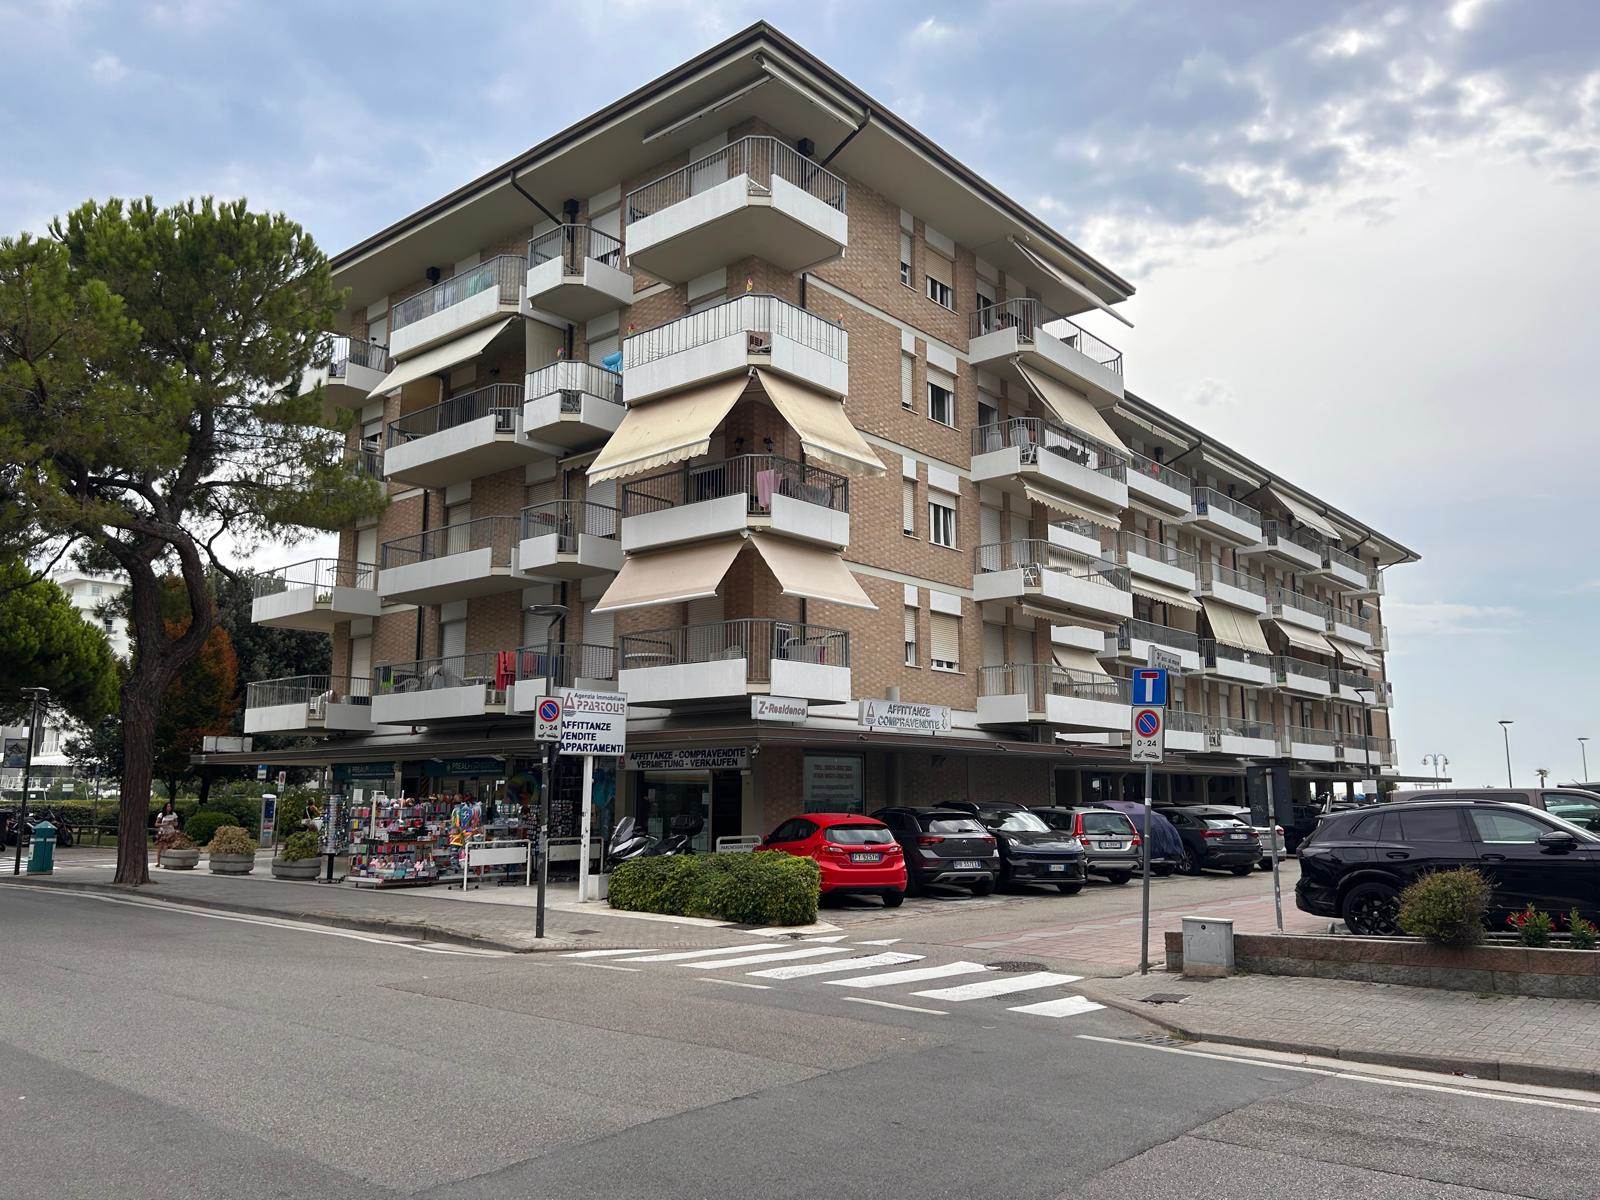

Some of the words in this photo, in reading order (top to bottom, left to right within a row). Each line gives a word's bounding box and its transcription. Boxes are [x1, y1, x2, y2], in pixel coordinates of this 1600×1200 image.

[574, 692, 596, 700] Agenzia
[596, 694, 626, 702] Immobiliare
[758, 700, 806, 716] Z-Residence
[887, 703, 931, 717] AFFITTANZE
[561, 720, 612, 731] AFFITTANZE
[877, 715, 940, 730] COMPRAVENDITE
[560, 731, 597, 741] VENDITE
[559, 742, 624, 754] APPARTAMENTI
[630, 751, 673, 760] AFFITTANZE
[679, 748, 746, 759] COMPRAVENDITE
[636, 759, 684, 769] VERMIETUNG
[690, 758, 738, 767] VERKAUFEN
